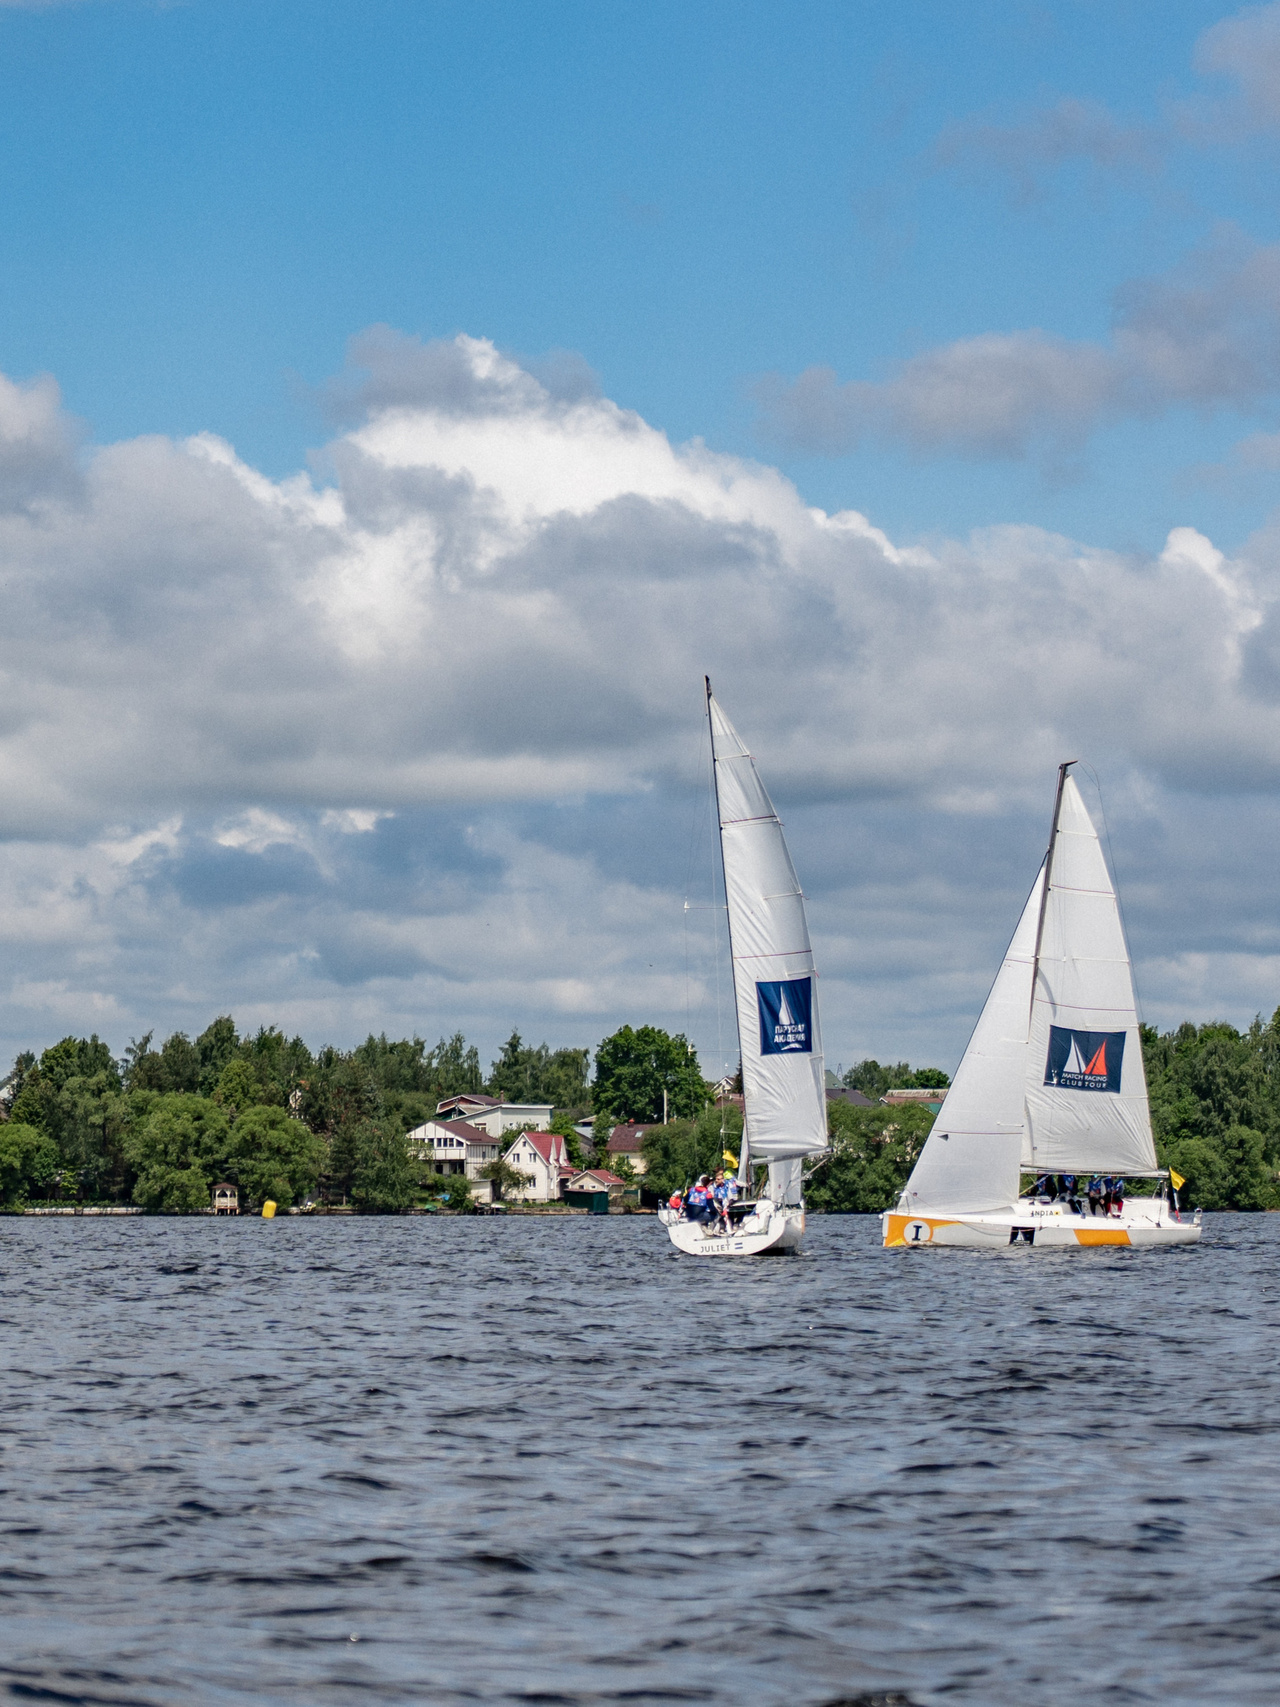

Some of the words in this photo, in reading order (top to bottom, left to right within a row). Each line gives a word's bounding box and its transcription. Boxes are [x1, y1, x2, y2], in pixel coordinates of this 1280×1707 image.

[1062, 1072, 1084, 1080] MATCH
[1084, 1075, 1107, 1083] RACING
[1060, 1079, 1083, 1087] CLUB
[912, 1225, 922, 1241] I
[700, 1244, 731, 1253] JULIET
